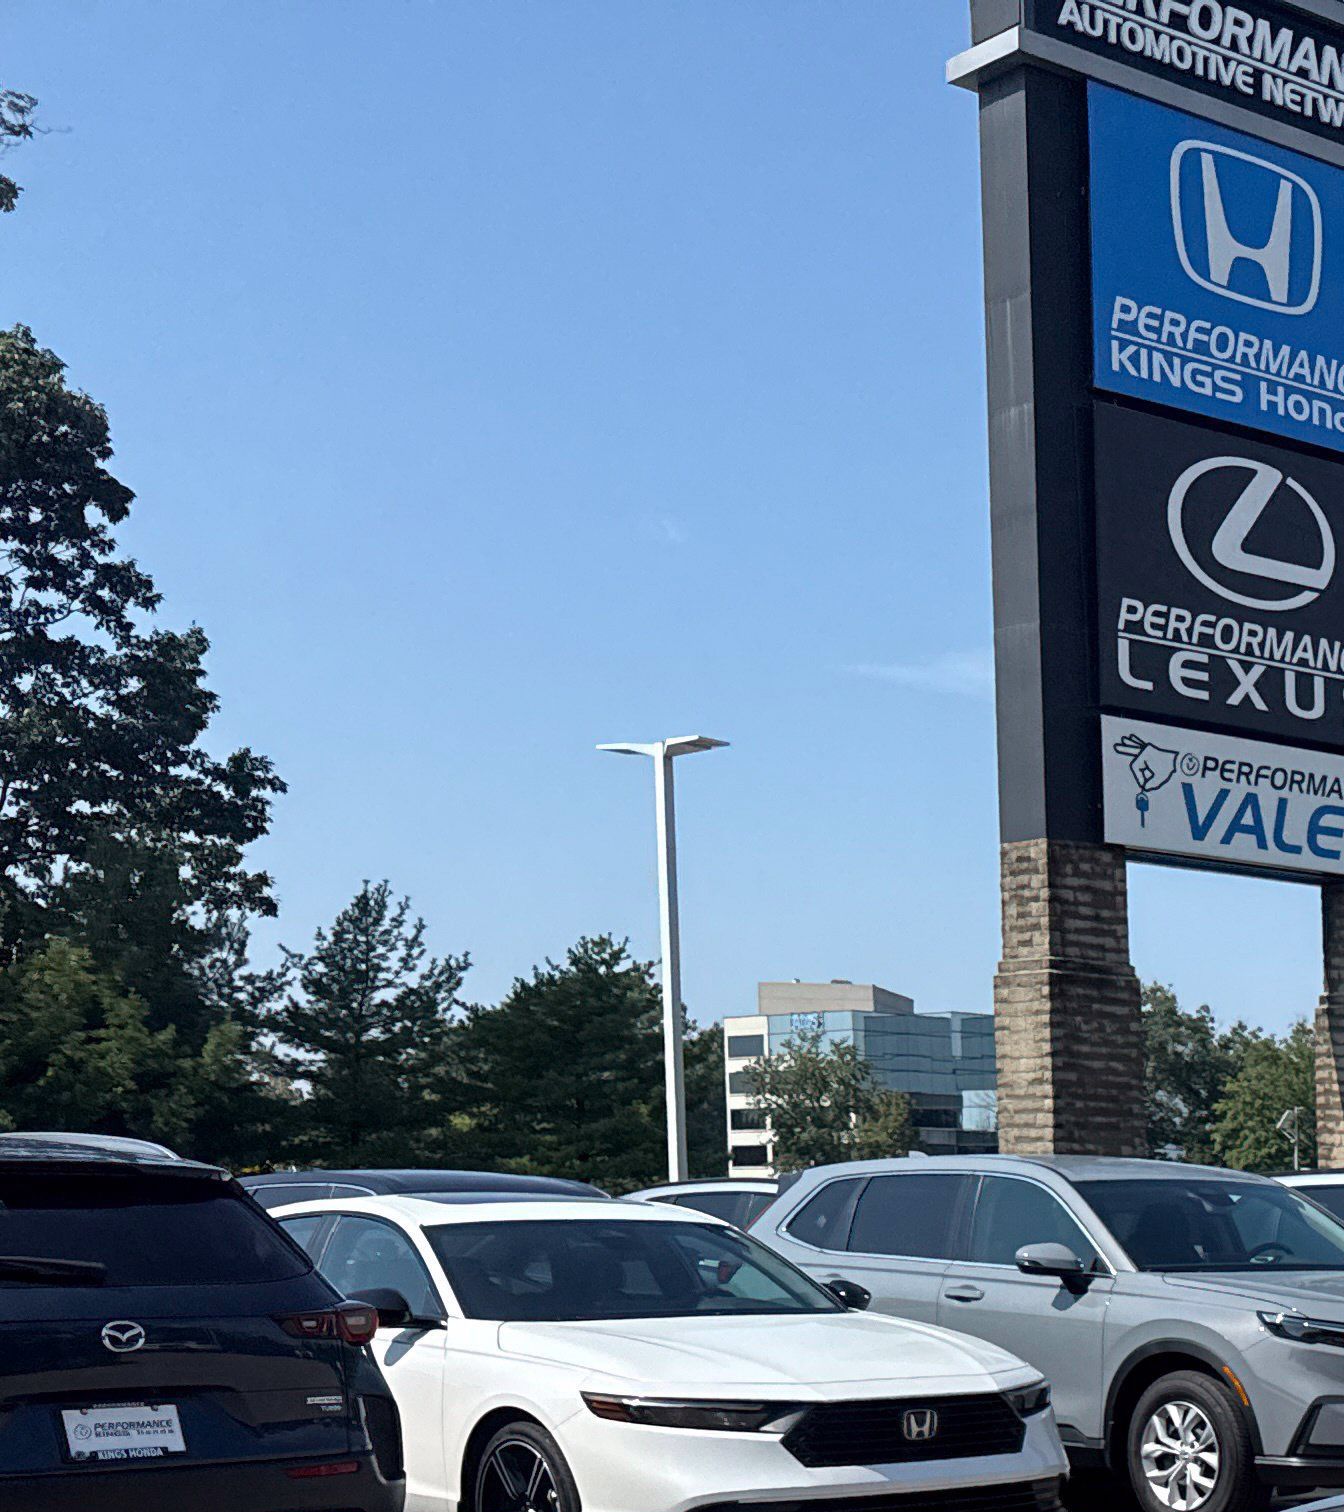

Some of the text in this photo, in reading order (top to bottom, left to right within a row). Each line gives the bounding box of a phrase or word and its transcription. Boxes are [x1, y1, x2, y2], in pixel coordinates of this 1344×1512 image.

[1057, 0, 1254, 95] AUTOMOTIVE
[1111, 341, 1242, 403] KINGS
[94, 1419, 173, 1431] PERFORMANCE
[98, 1448, 127, 1460] KINGS
